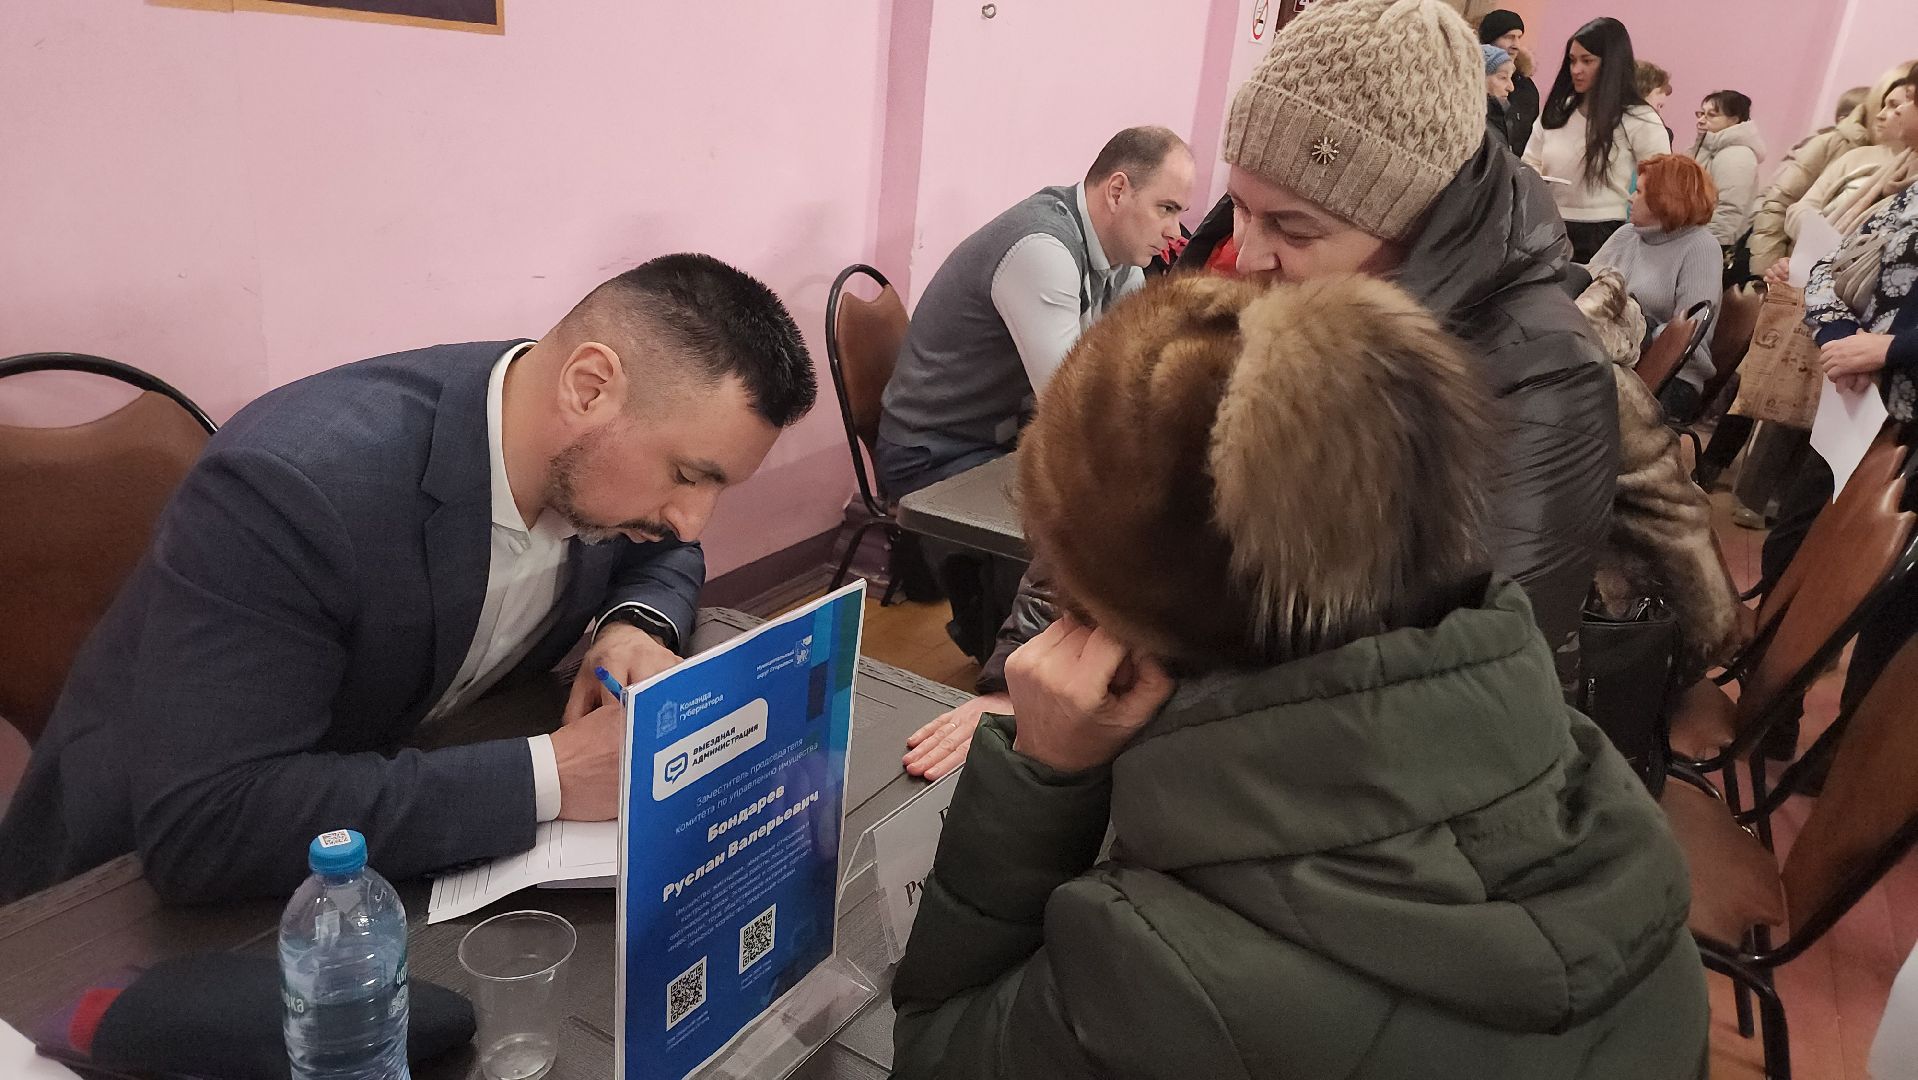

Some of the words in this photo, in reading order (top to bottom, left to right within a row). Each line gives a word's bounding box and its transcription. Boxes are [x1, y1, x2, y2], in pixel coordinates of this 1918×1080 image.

[680, 691, 712, 712] Команда
[680, 694, 724, 721] губернатора
[692, 723, 759, 767] АДМИНИСТРАЦИЯ
[693, 726, 736, 756] ВЫЕЗДНАЯ
[675, 804, 715, 834] комитета
[717, 797, 728, 809] по
[728, 769, 777, 805] управлению
[778, 743, 819, 772] имущества
[696, 770, 749, 806] Заместитель
[750, 738, 804, 774] председателя
[707, 785, 785, 843] Бондарев
[662, 851, 725, 903] Руслан
[727, 790, 819, 859] Валерьевич
